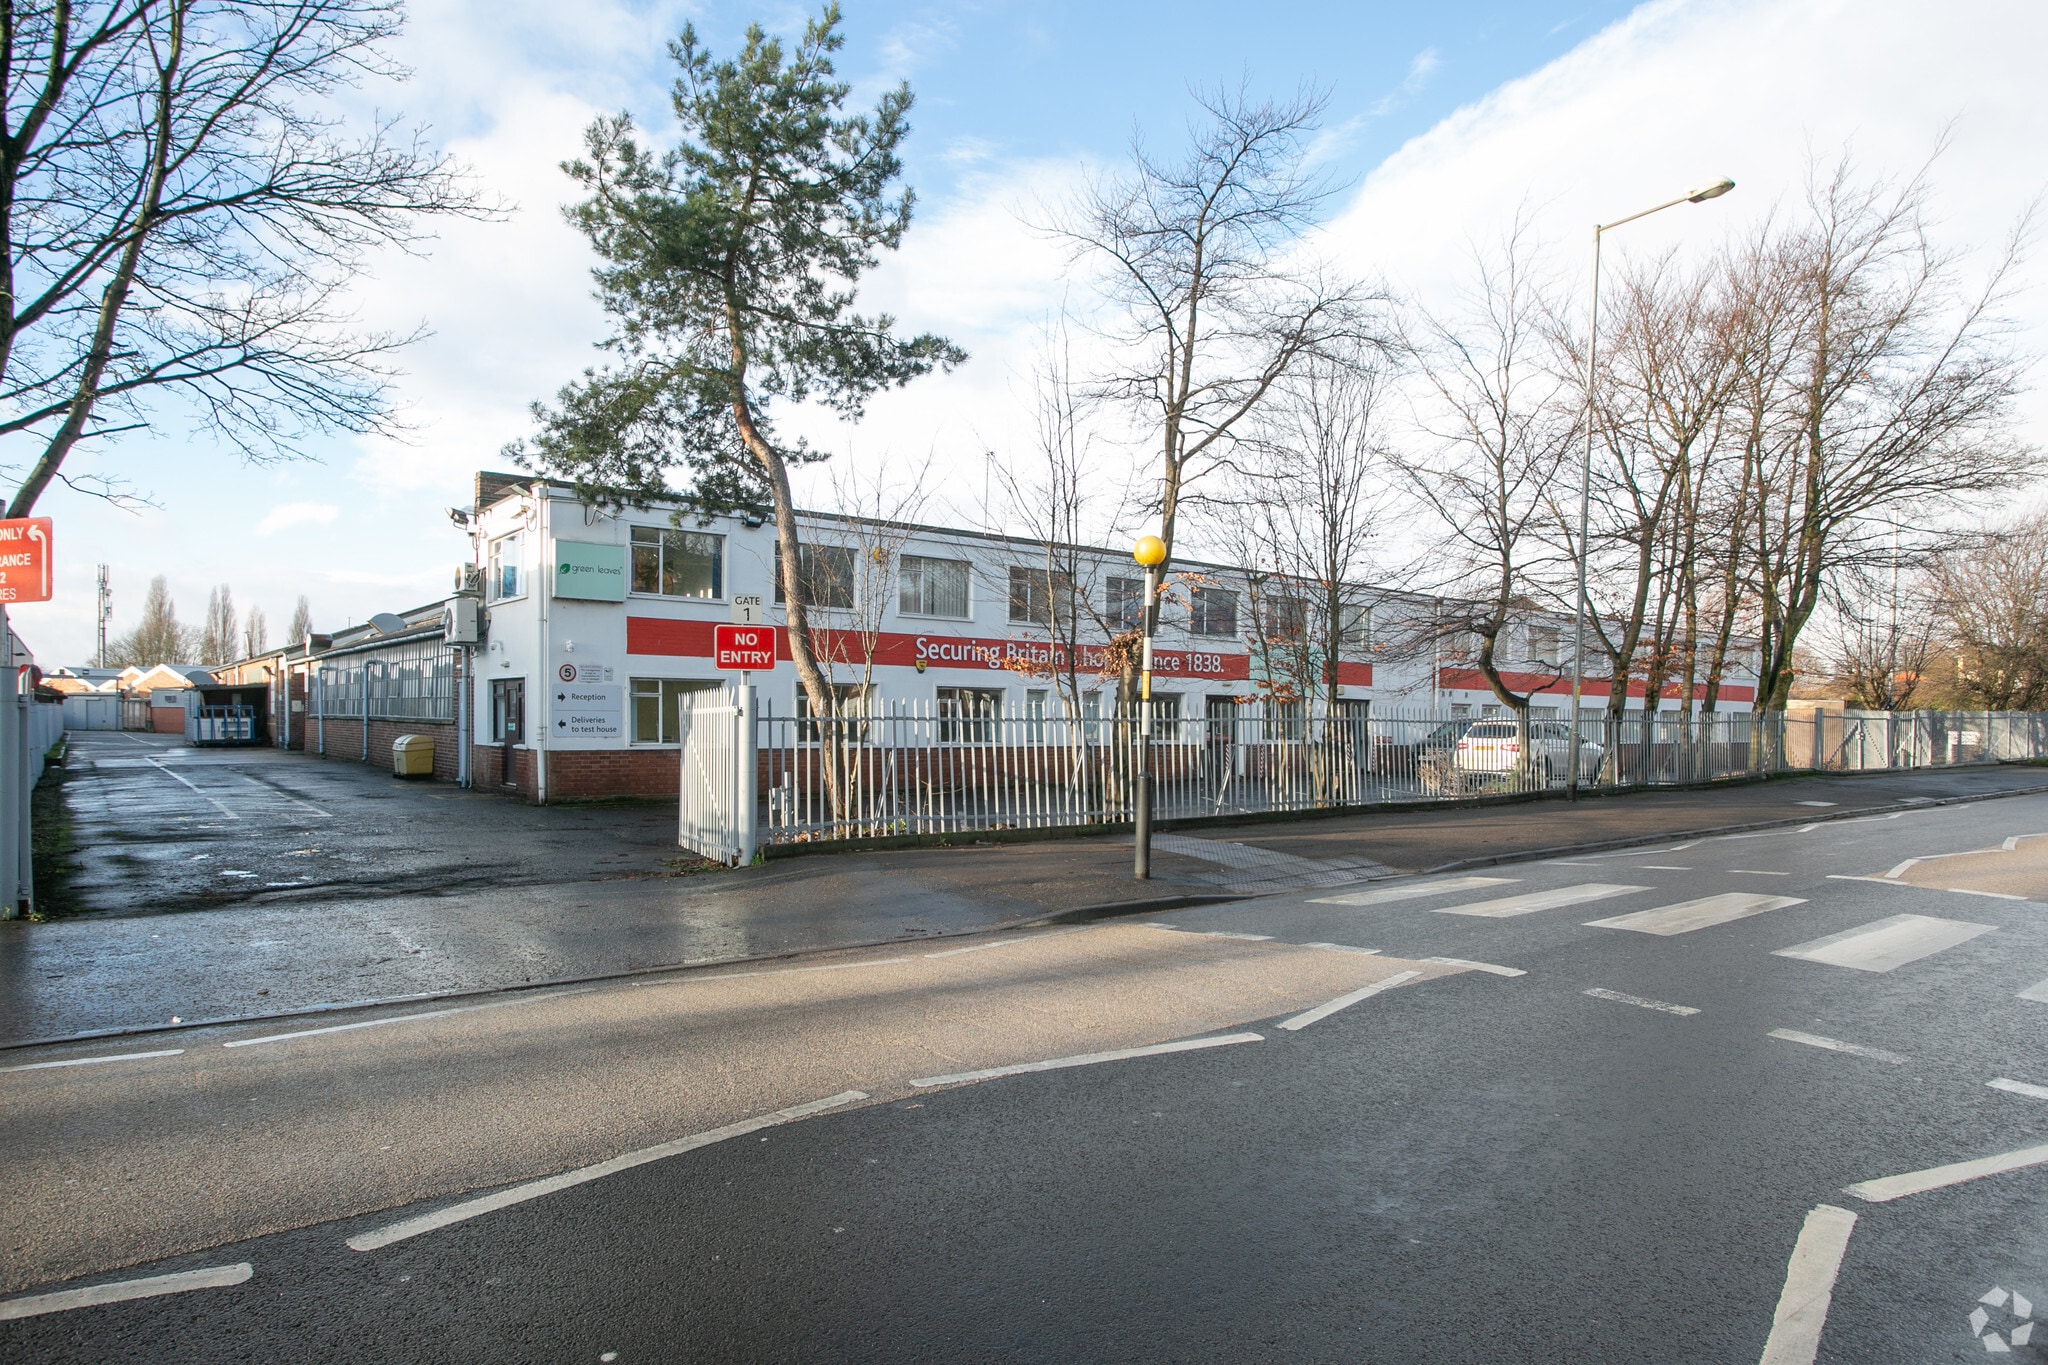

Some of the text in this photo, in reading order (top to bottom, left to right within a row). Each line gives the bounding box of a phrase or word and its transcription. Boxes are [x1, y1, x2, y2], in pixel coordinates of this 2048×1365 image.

[571, 564, 622, 576] green leaves
[0, 571, 7, 584] 2
[734, 596, 760, 606] GATE
[743, 607, 750, 622] 1
[734, 632, 758, 646] NO
[720, 650, 772, 664] ENTRY
[915, 637, 1000, 669] Securing
[1185, 653, 1225, 673] 1838.
[563, 667, 572, 678] 5
[571, 693, 606, 702] Reception
[571, 716, 606, 724] Deliveries
[596, 725, 617, 733] house
